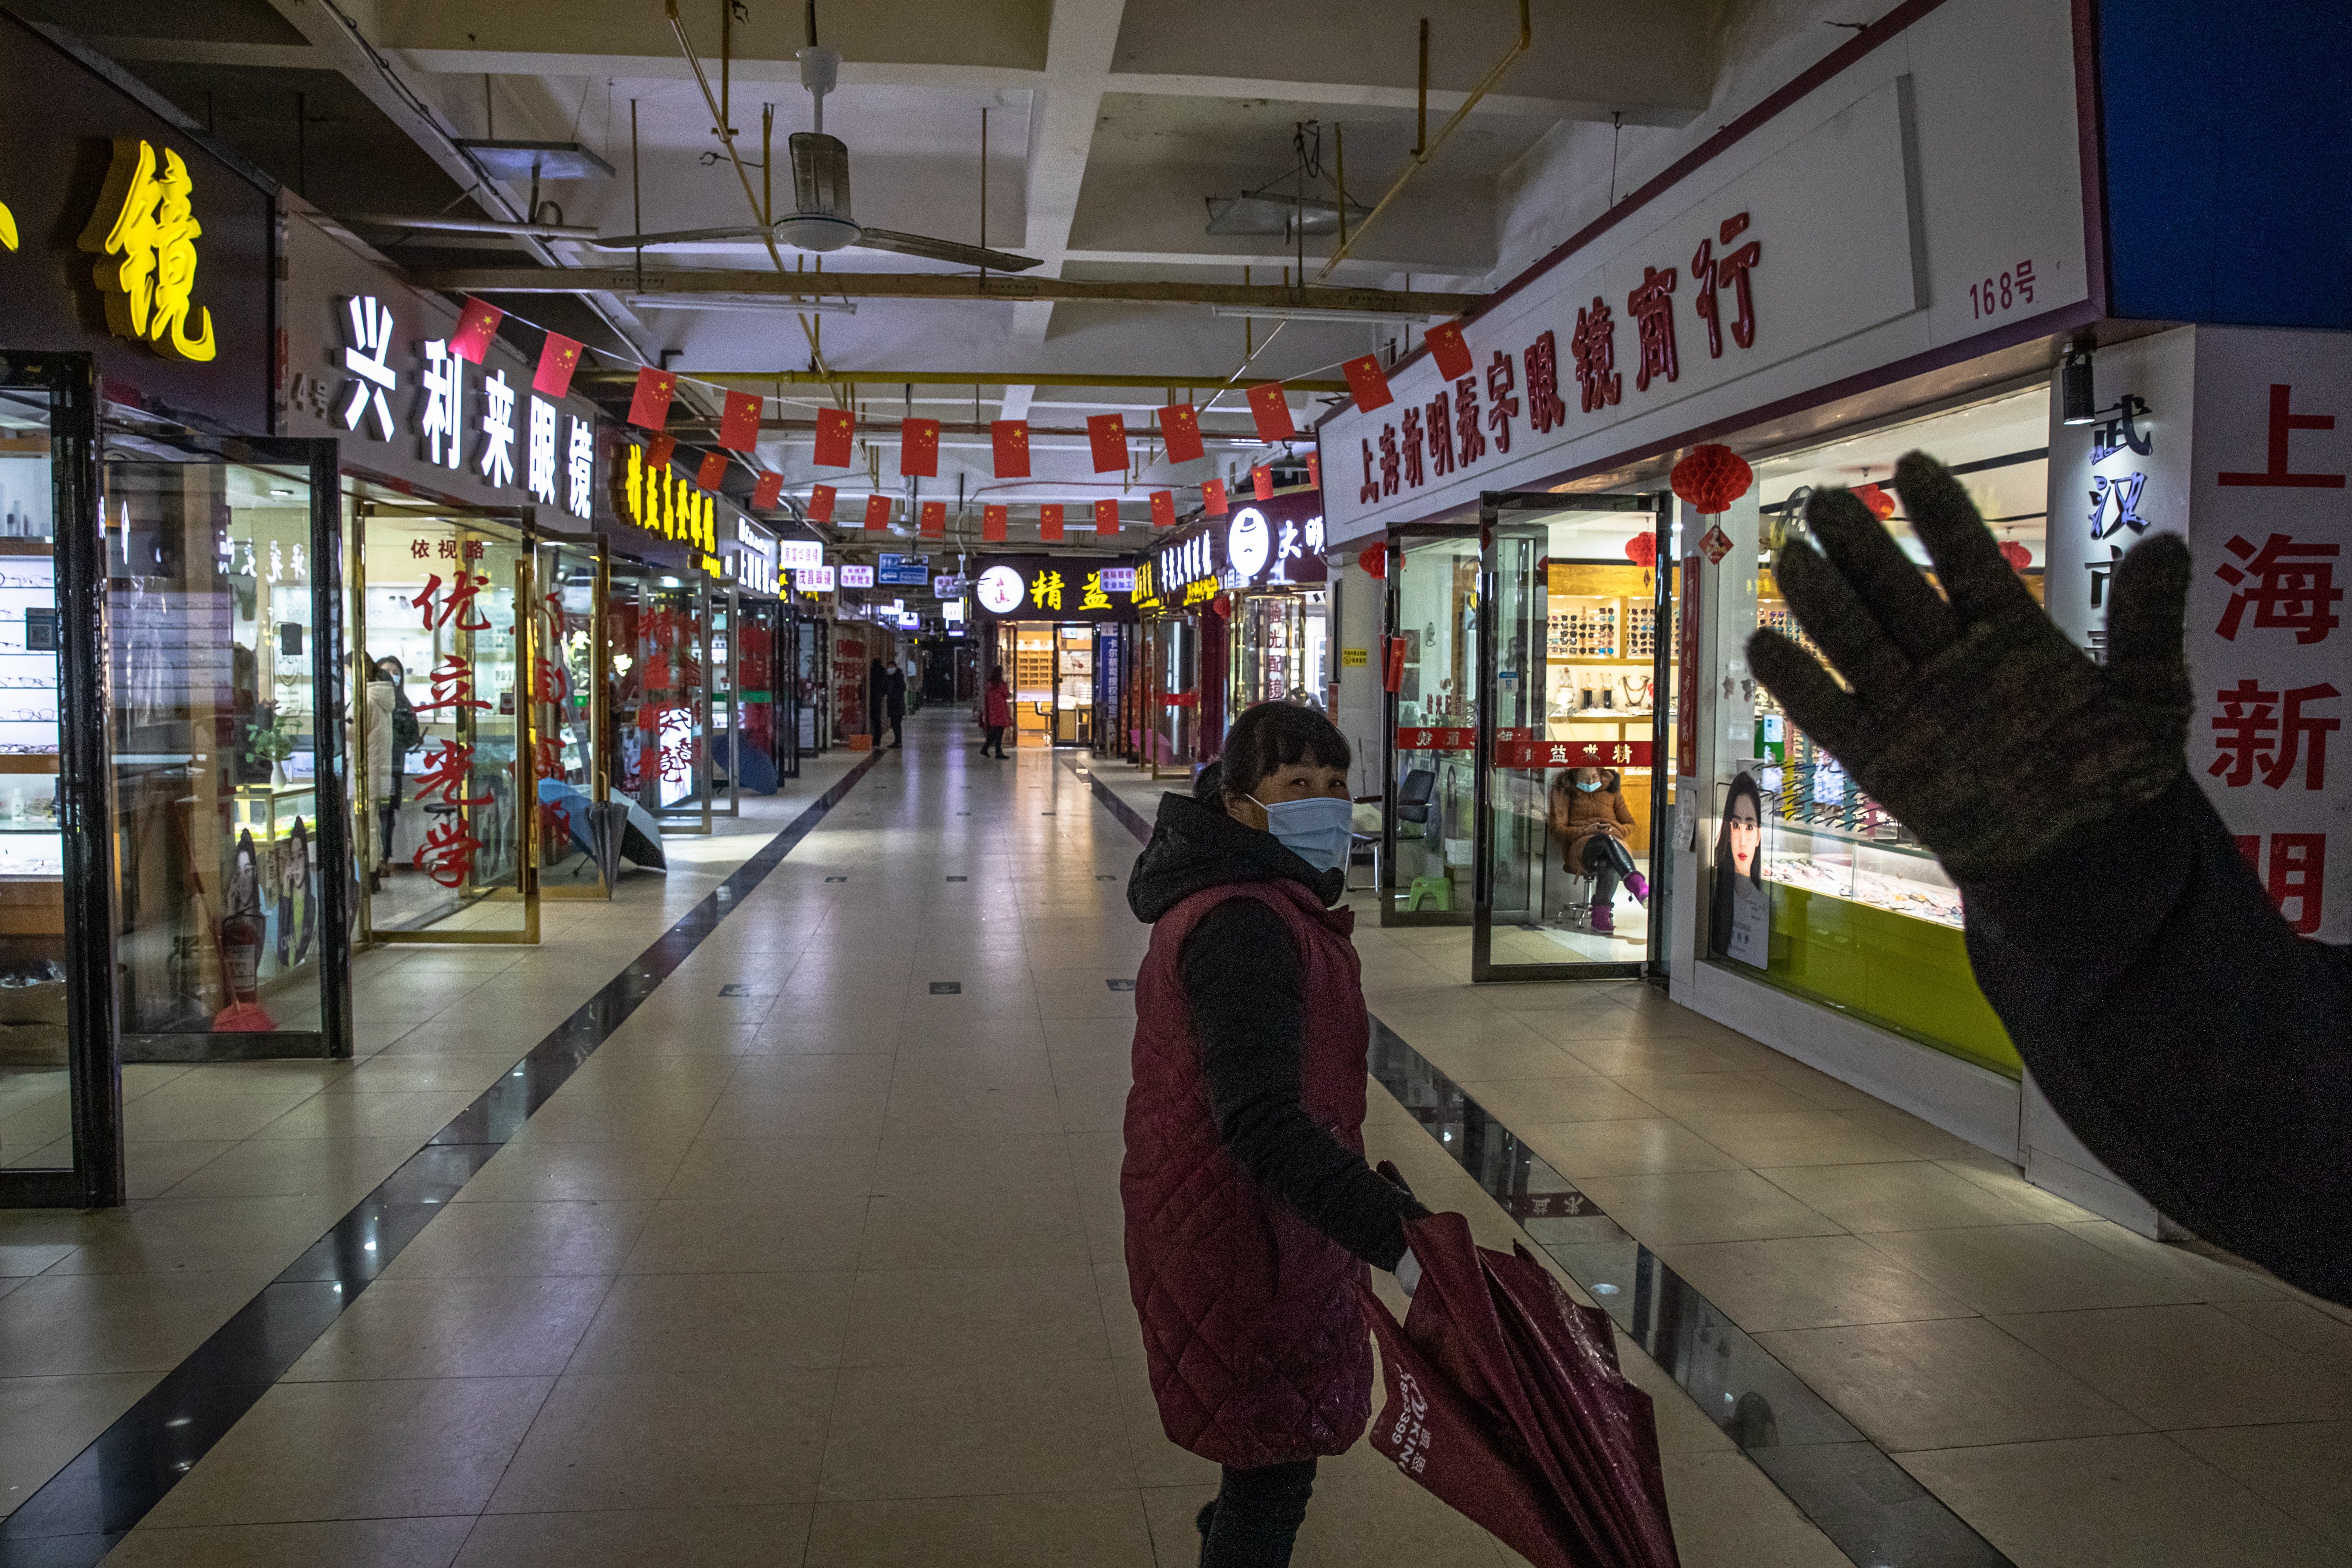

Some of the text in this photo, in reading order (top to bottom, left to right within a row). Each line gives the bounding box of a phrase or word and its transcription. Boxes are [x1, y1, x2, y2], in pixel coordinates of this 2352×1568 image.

[1360, 212, 1760, 504] 上海新明振宇眼镜商行
[1970, 260, 2036, 319] 168号
[345, 295, 593, 519] 兴利来眼镜
[411, 539, 485, 560] 依视路
[1030, 570, 1113, 611] 精益
[2083, 394, 2153, 664] 武汉
[411, 571, 495, 889] 优立光学
[1269, 603, 1283, 702] 验光配镜
